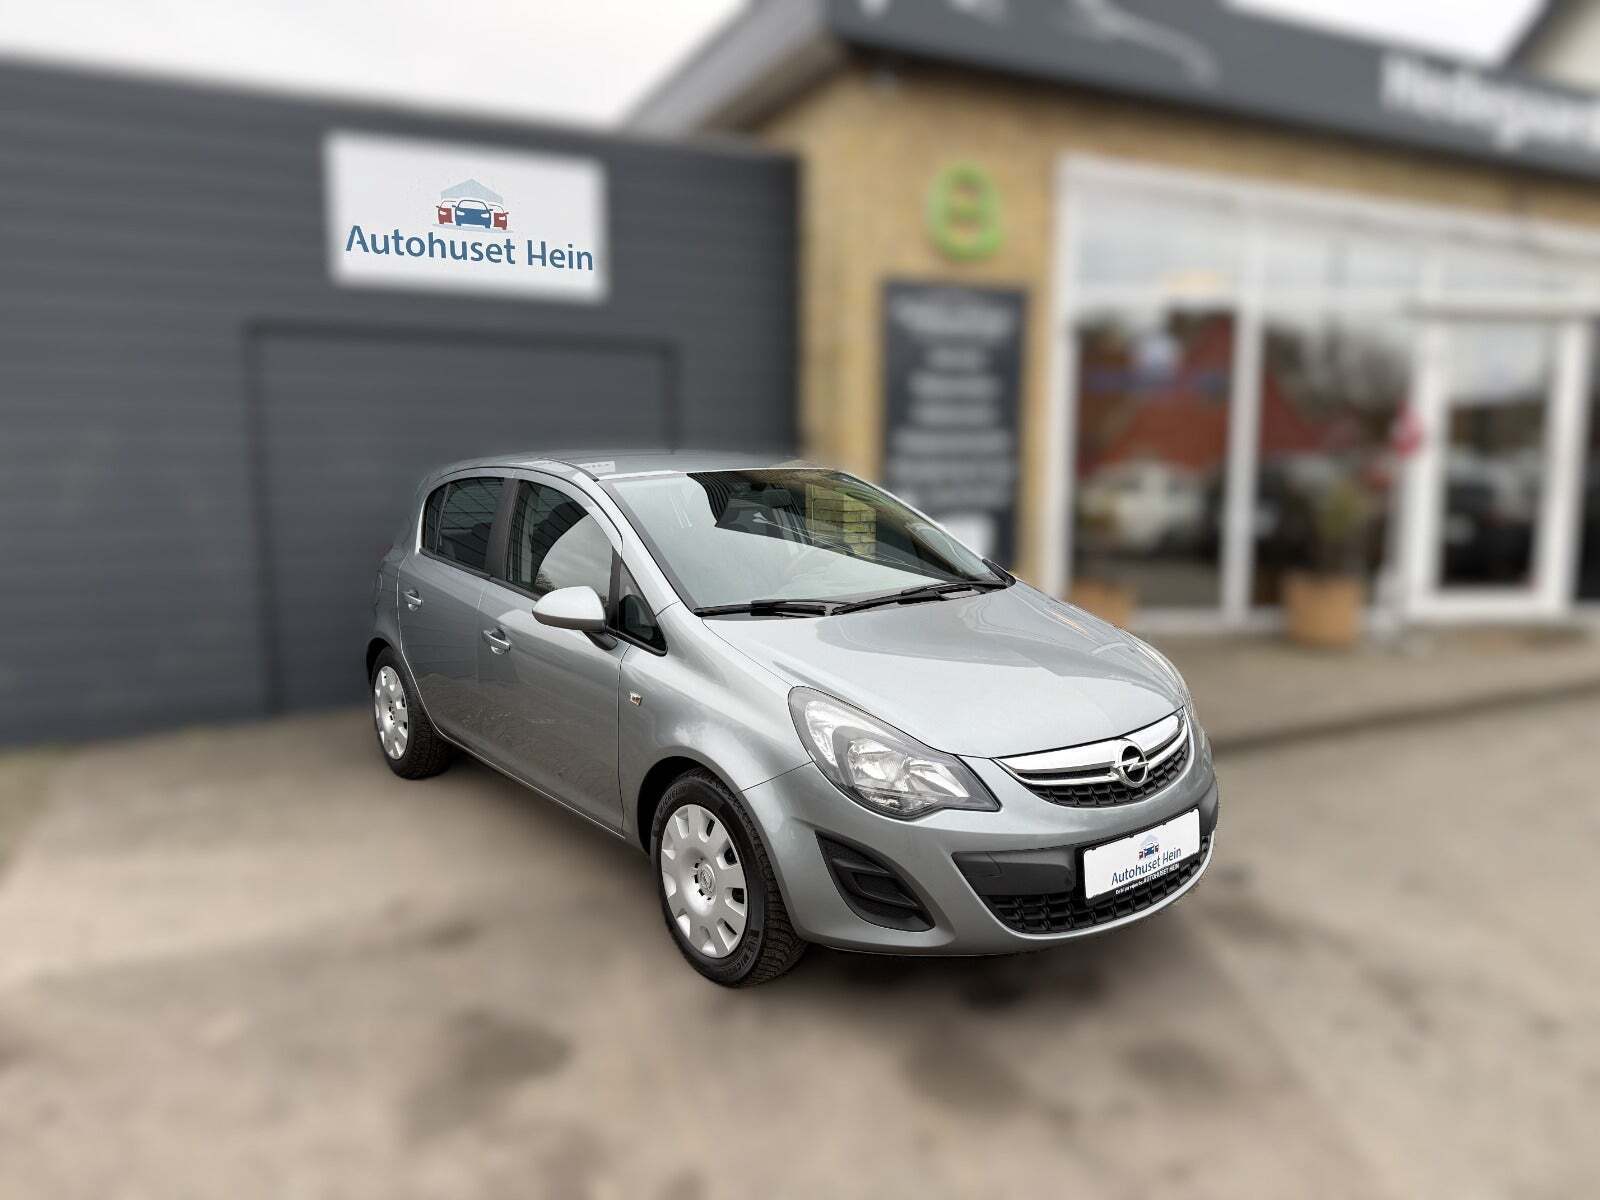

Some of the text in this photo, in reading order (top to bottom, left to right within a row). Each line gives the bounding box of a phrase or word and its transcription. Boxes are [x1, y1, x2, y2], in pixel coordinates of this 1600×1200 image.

[345, 225, 594, 271] Autohuset Hein
[1111, 847, 1182, 886] Autohuset Hein
